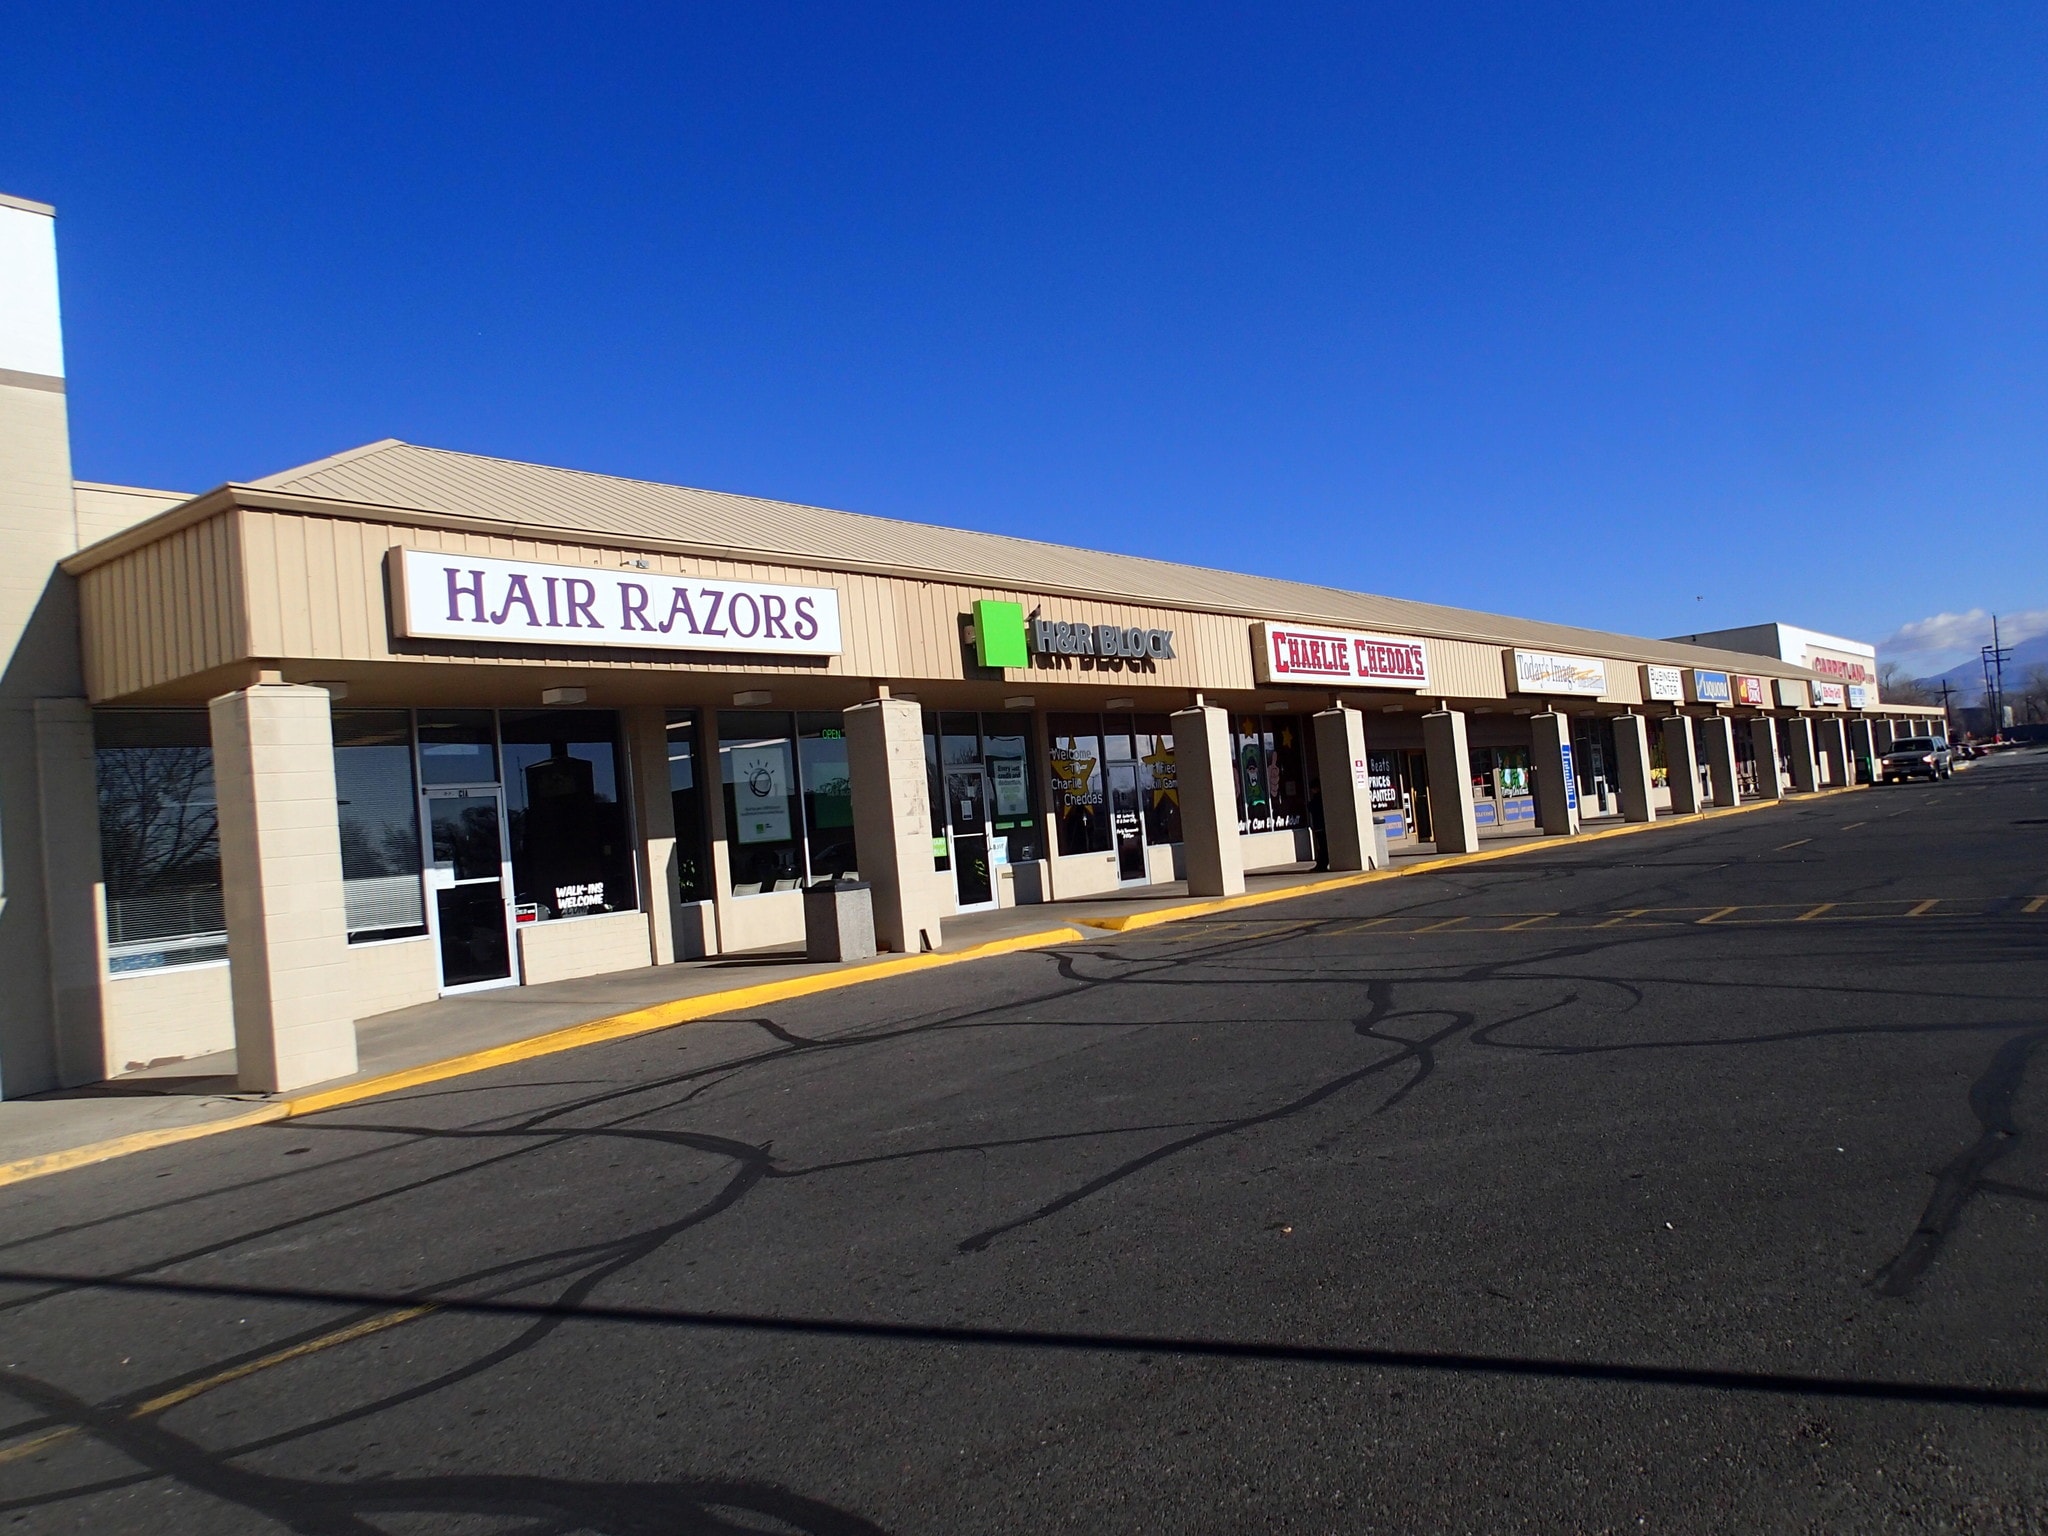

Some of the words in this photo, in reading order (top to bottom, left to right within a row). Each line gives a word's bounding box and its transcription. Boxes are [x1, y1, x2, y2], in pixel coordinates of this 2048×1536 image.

[443, 567, 604, 628] HAIR
[617, 582, 818, 640] RAZORS
[1033, 619, 1094, 655] H&R
[1097, 624, 1176, 660] BLOCK
[1272, 631, 1350, 673] CHARLIE
[1354, 639, 1424, 677] CHEDDA'S
[1517, 655, 1550, 688] Today's
[1550, 658, 1576, 690] Image
[1650, 668, 1679, 683] BUSINESS
[1654, 682, 1678, 696] CENTER
[822, 729, 841, 740] OPEN
[1064, 792, 1103, 805] Cheddas
[1368, 788, 1396, 802] RANTEED
[555, 882, 604, 898] WALK-INS
[557, 893, 604, 909] WELCOME
